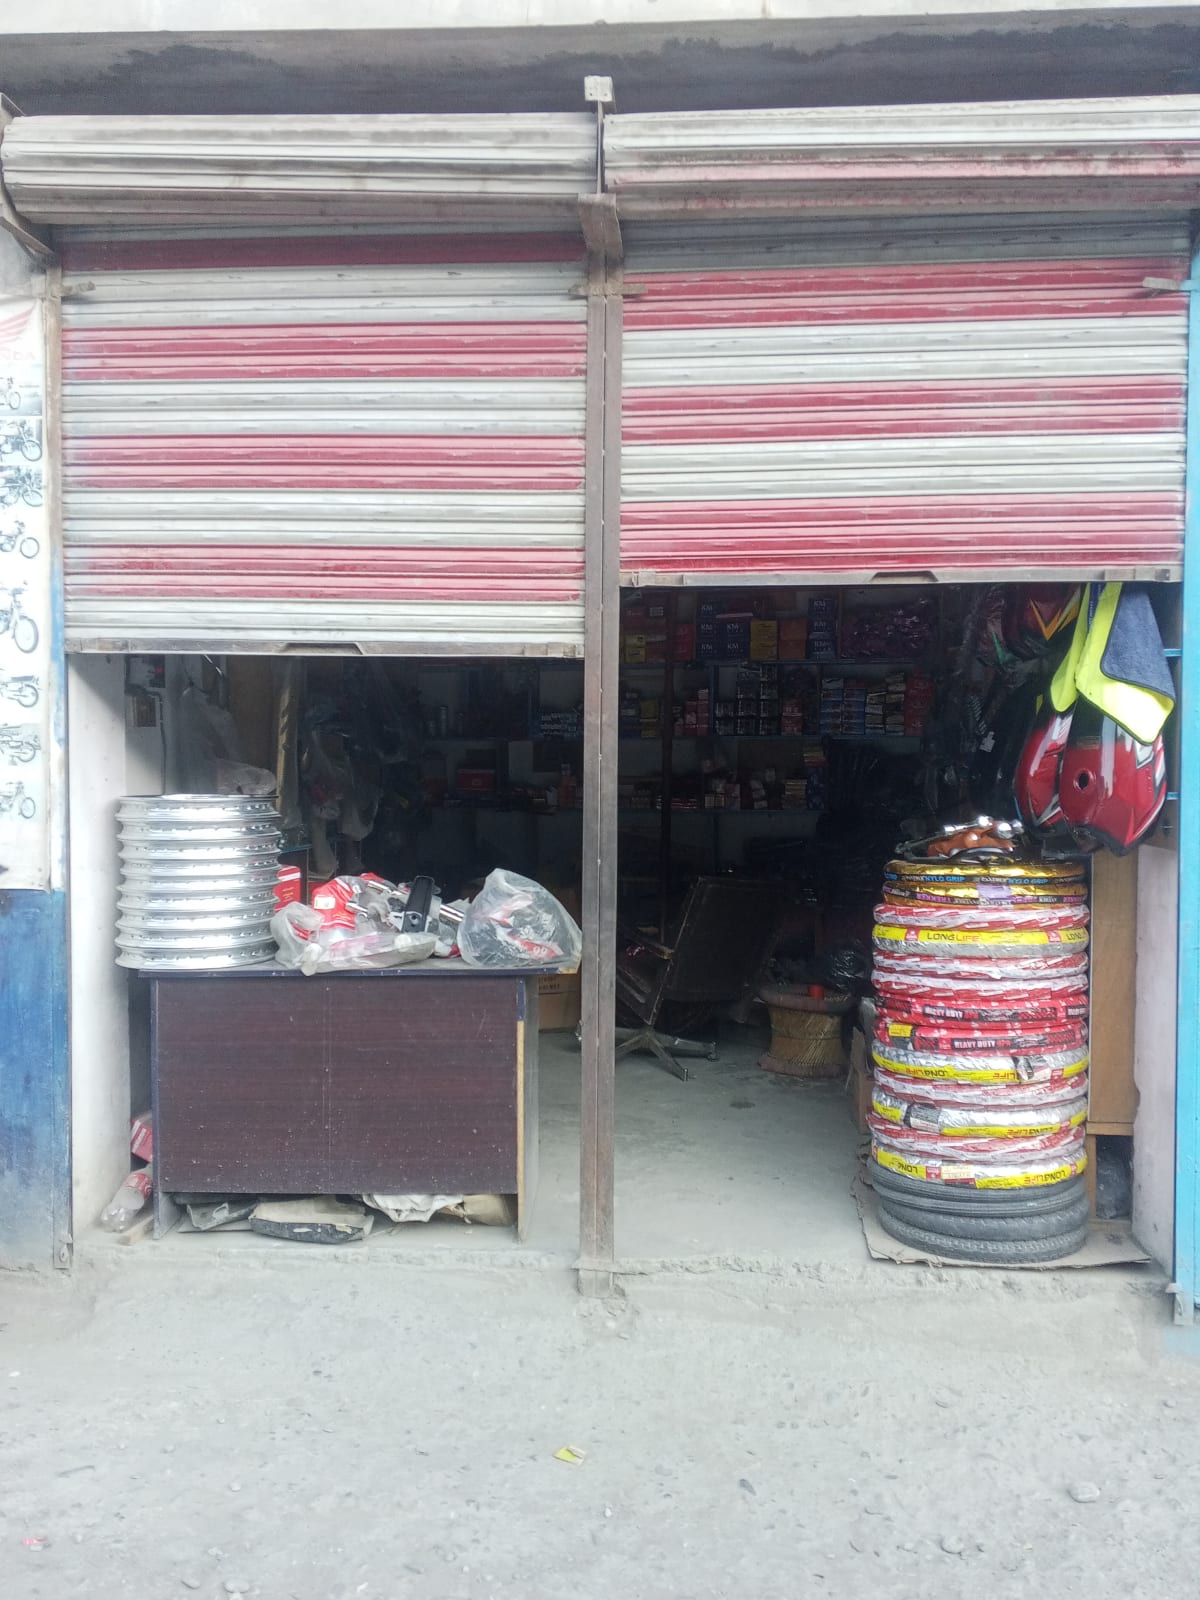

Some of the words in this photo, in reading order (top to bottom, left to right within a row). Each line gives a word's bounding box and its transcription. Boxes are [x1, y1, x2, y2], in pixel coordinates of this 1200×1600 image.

[945, 1008, 963, 1018] DUTY
[954, 1041, 977, 1049] HEAVY
[977, 1040, 996, 1048] DUTY
